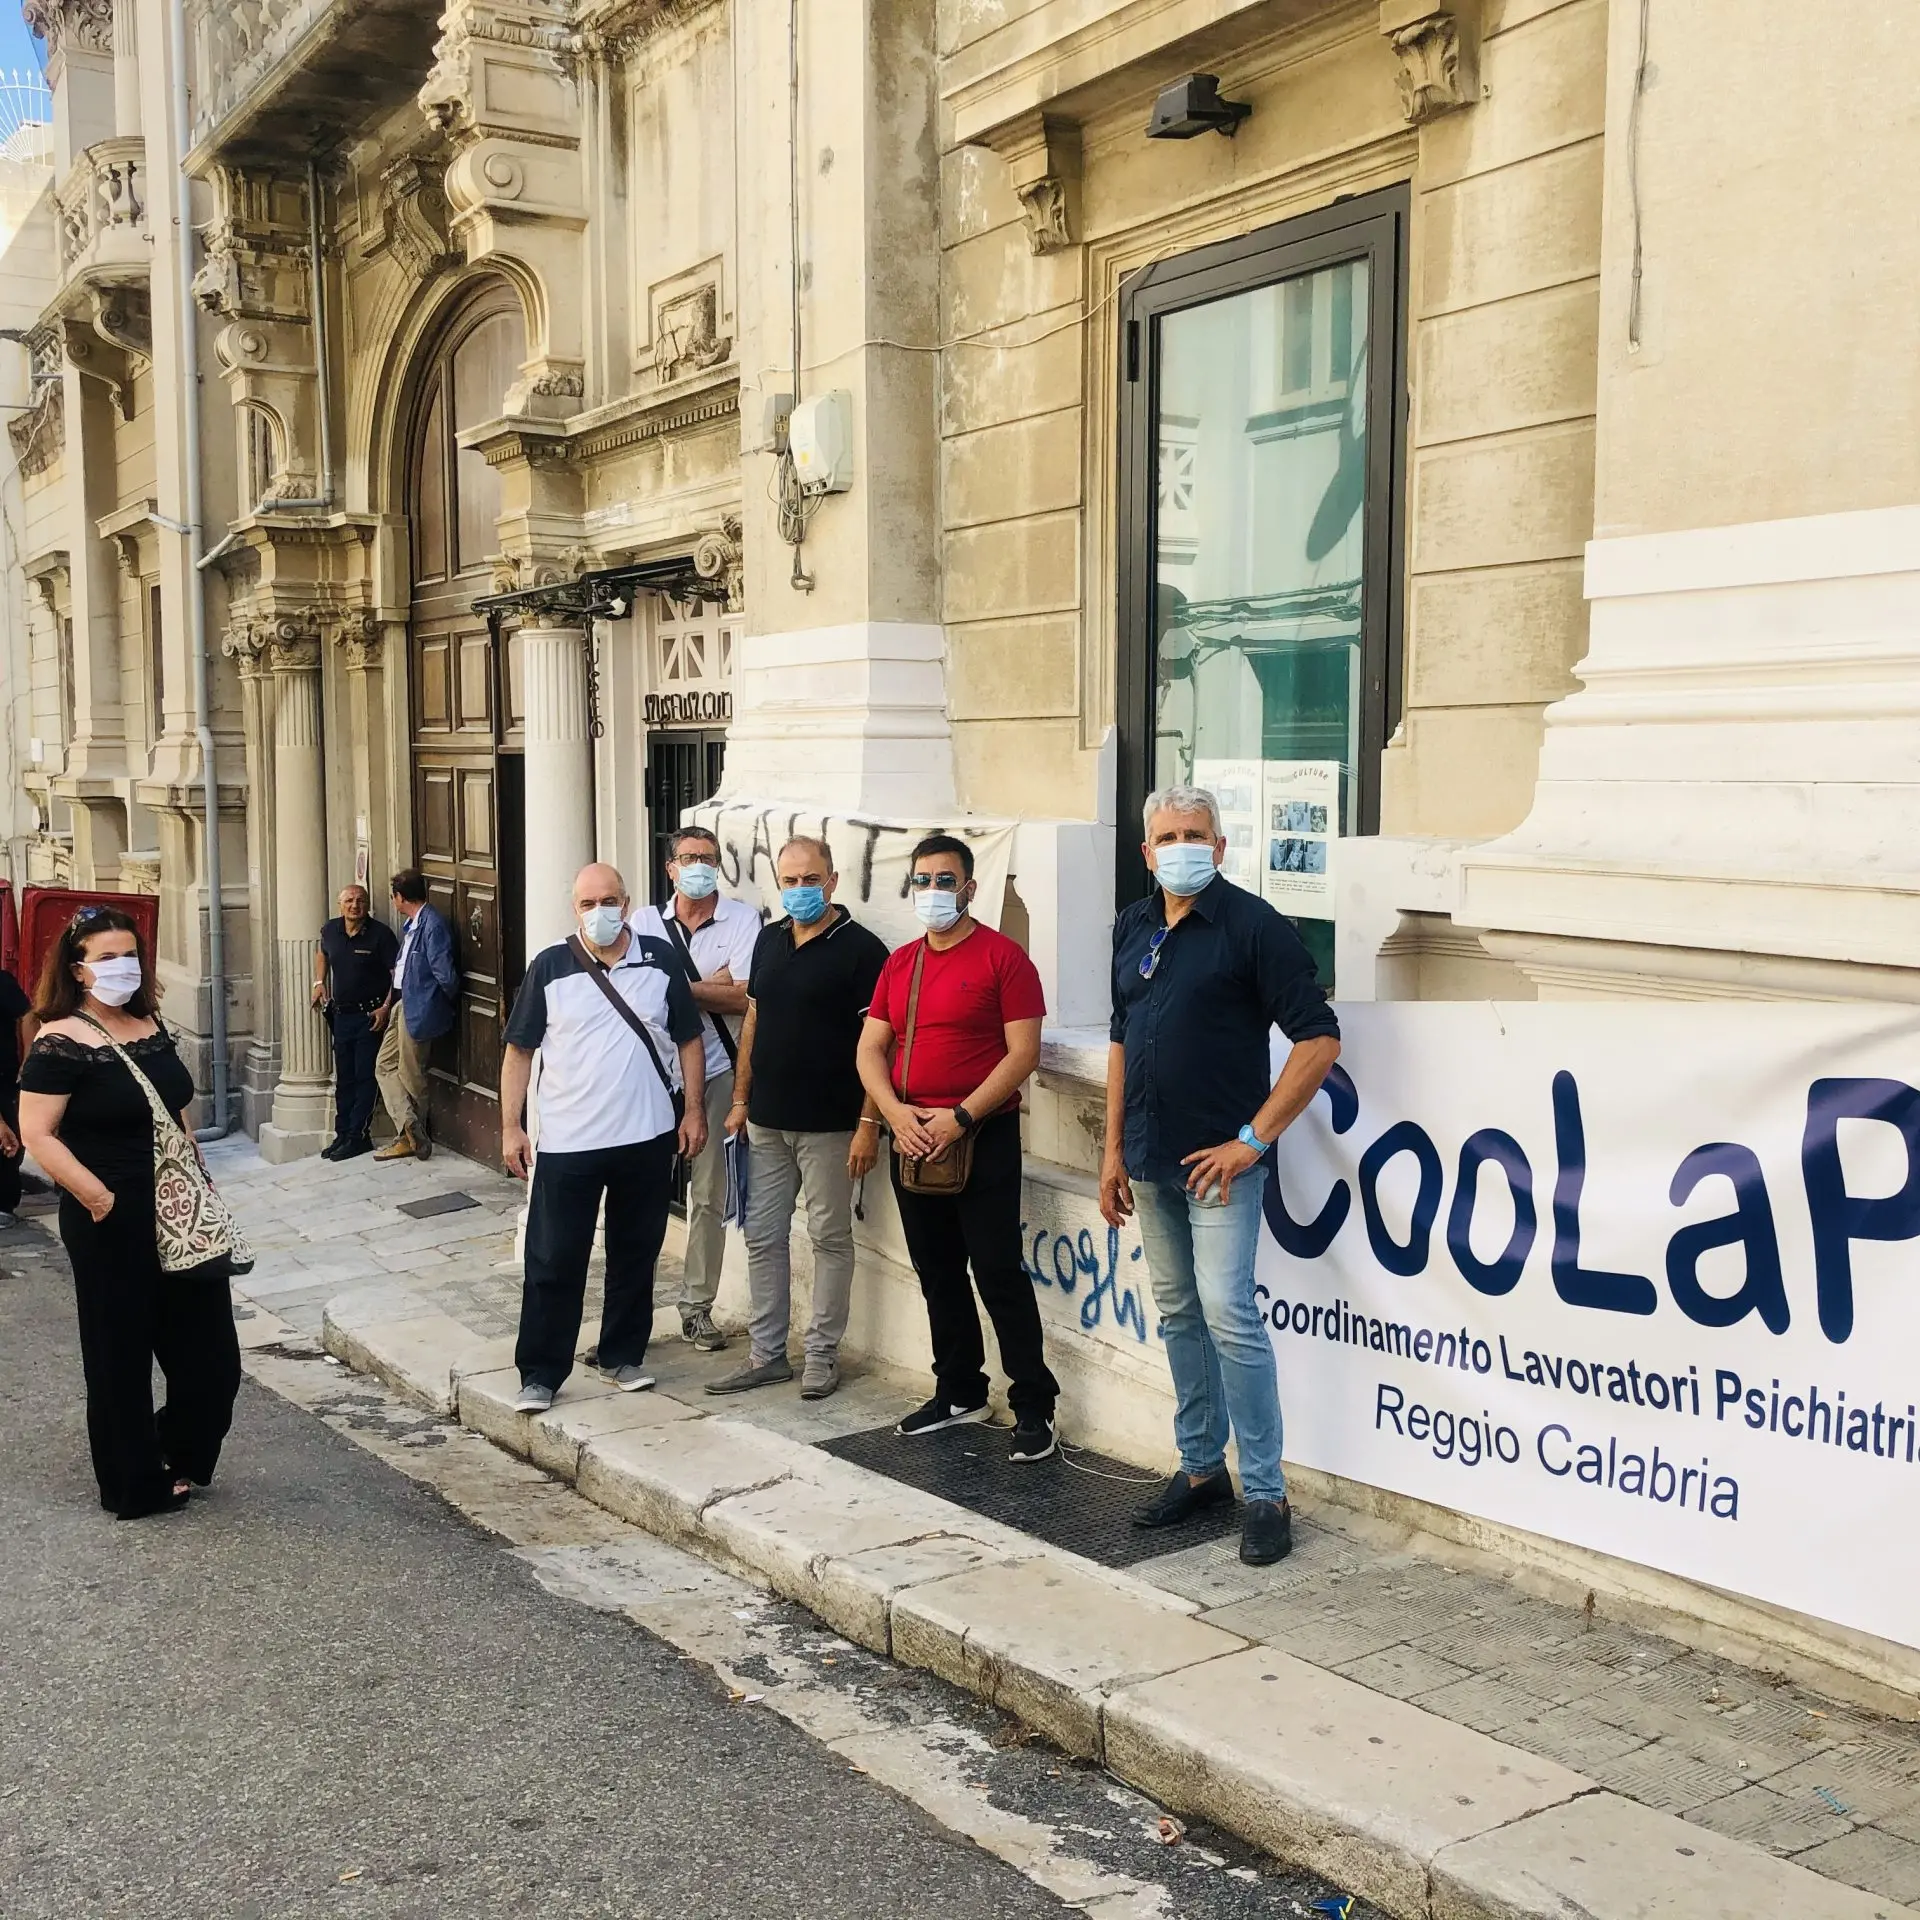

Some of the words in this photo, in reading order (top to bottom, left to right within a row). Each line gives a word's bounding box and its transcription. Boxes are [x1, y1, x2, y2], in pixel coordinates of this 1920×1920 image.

[1375, 1383, 1521, 1467] Reggio
[1537, 1423, 1739, 1521] Calabria
[1499, 1334, 1700, 1416] Lavoratori
[1715, 1368, 1920, 1464] Psichiatri
